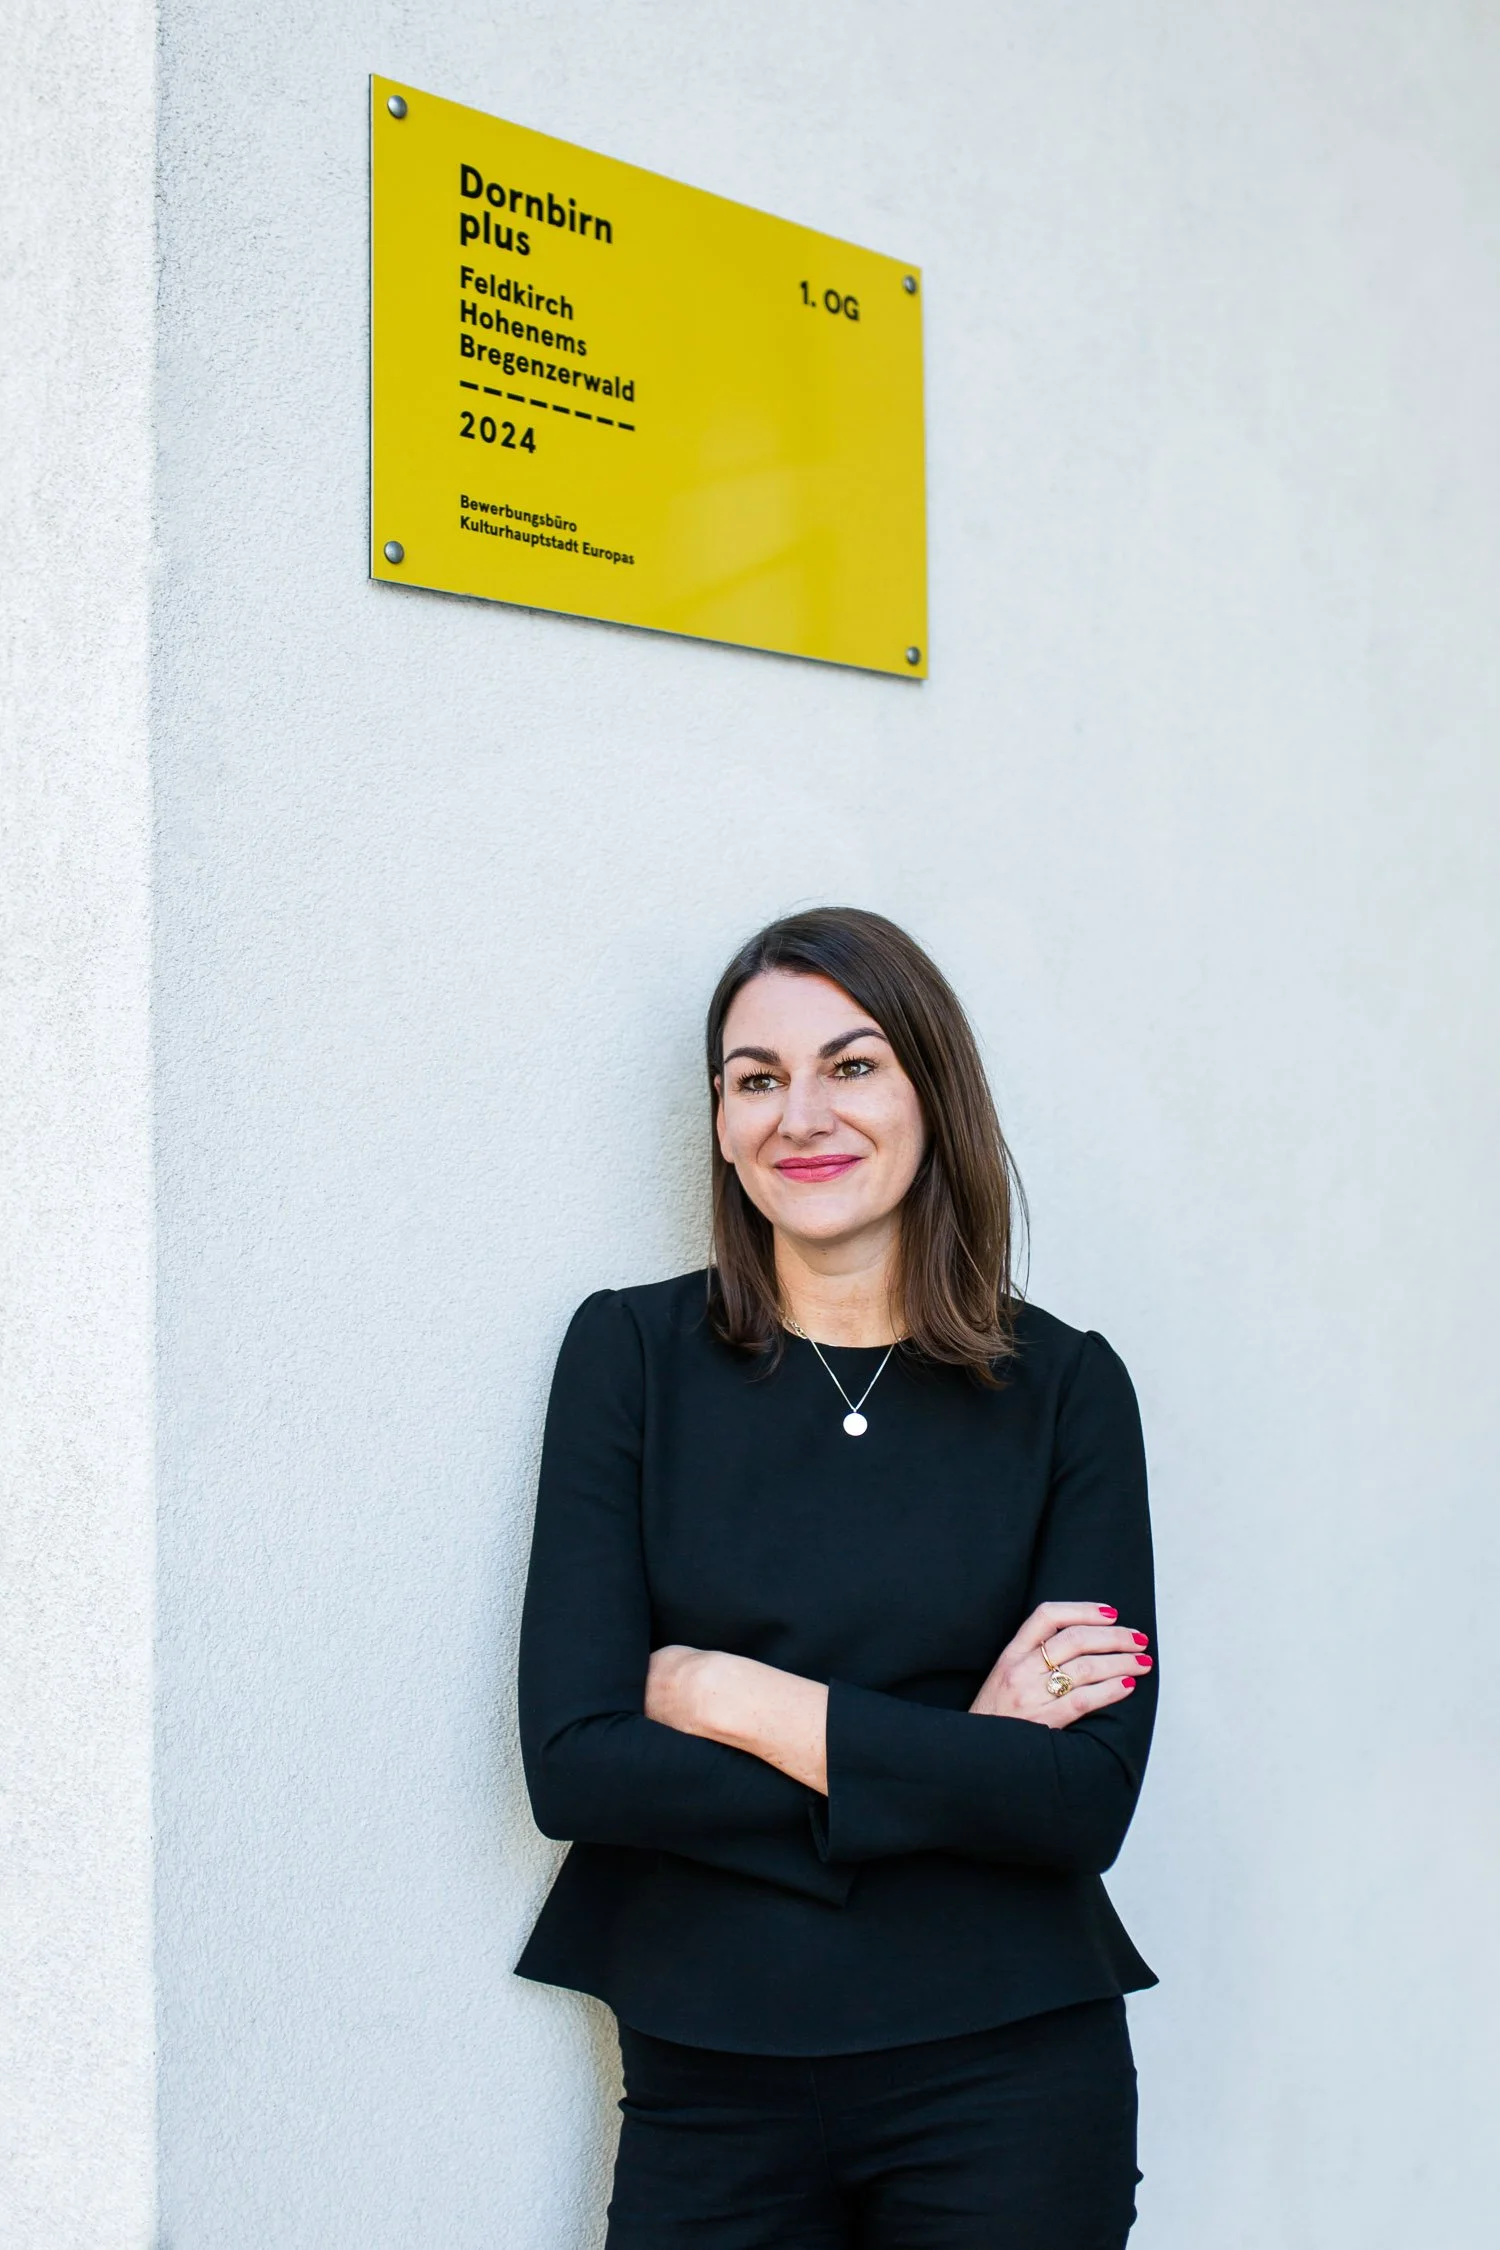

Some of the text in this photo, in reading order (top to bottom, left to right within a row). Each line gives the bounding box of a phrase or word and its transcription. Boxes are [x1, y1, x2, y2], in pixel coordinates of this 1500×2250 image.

[460, 163, 612, 244] Dornbirn
[460, 210, 531, 256] plus
[460, 265, 573, 321] Feldkirch
[800, 280, 860, 321] 1. OG
[460, 299, 587, 357] Hohenems
[460, 333, 635, 402] Bregenzerwald
[459, 410, 537, 454] 2024
[460, 494, 577, 533] Bewerbungsbüro
[460, 515, 635, 565] Kulturhauptstadt Europas
